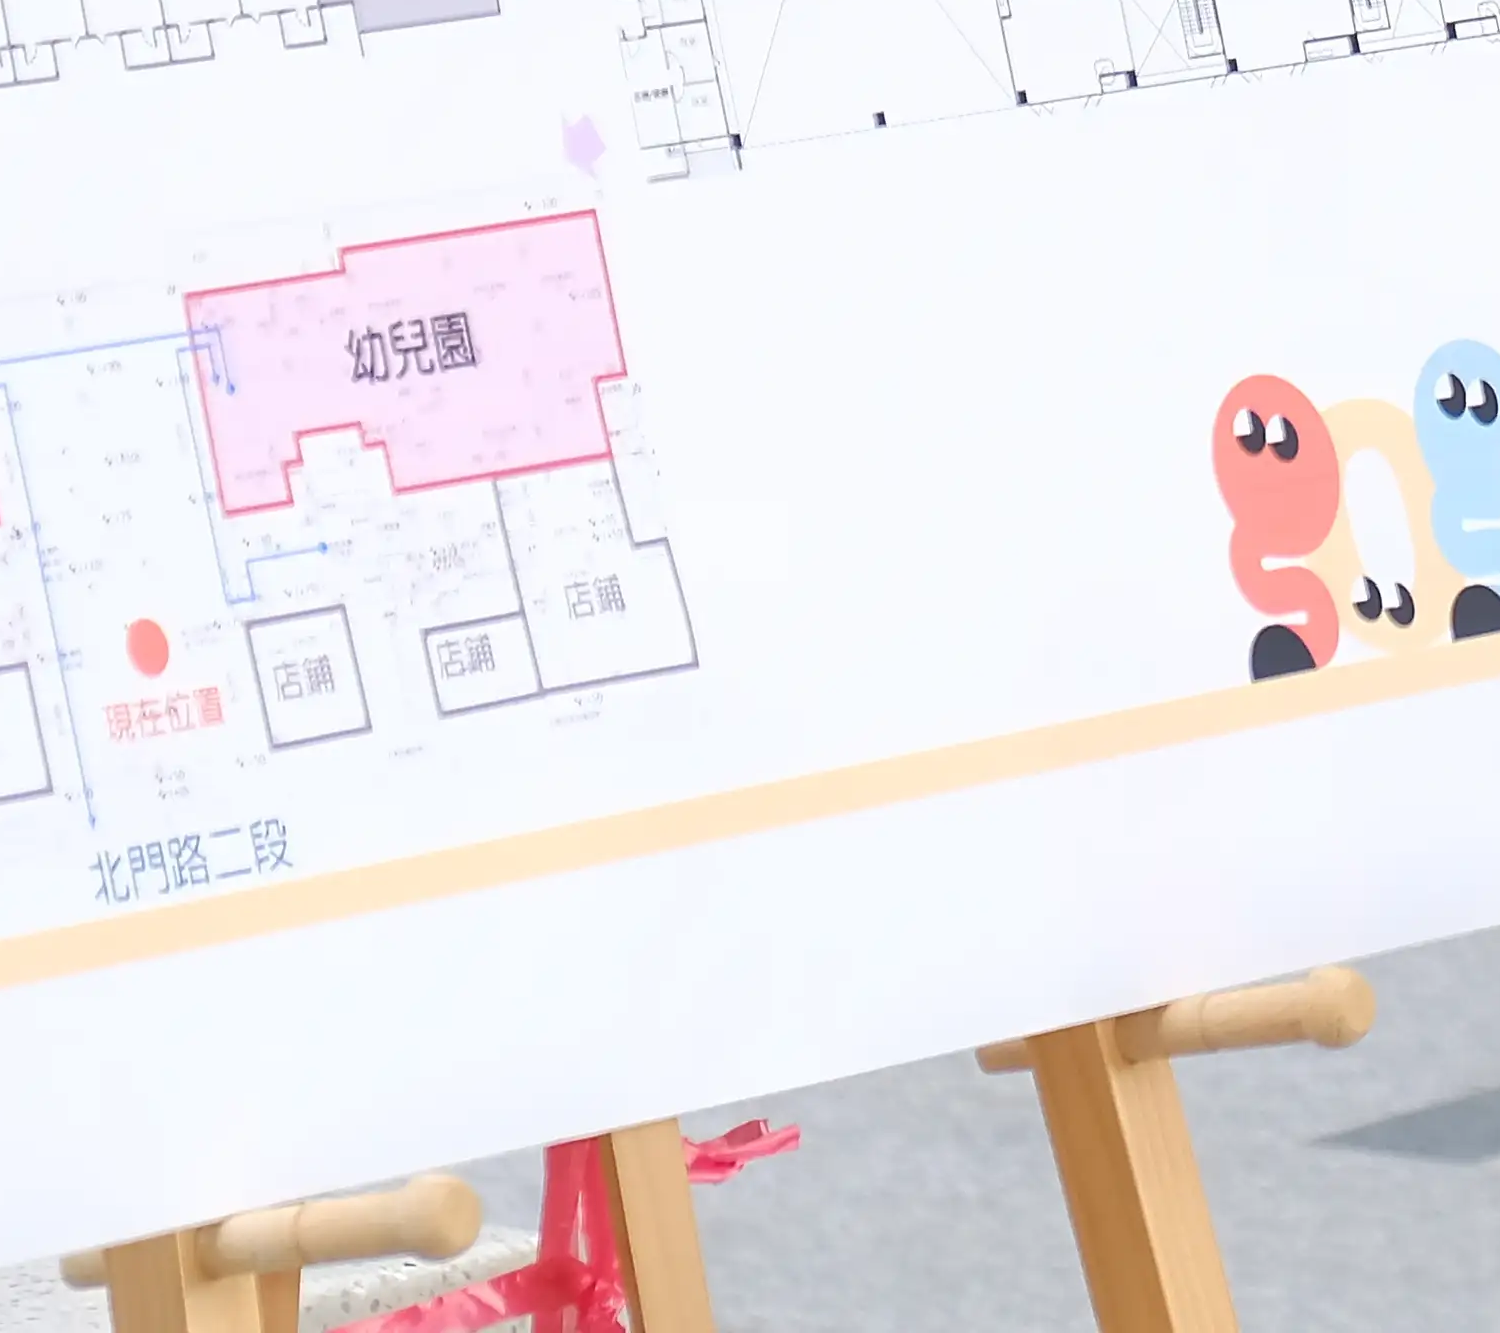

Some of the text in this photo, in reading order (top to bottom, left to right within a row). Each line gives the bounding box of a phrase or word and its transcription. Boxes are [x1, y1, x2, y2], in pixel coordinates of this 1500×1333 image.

[345, 312, 479, 385] 幼兒園
[103, 686, 225, 741] 現在位置
[88, 818, 294, 905] 北門路二段
